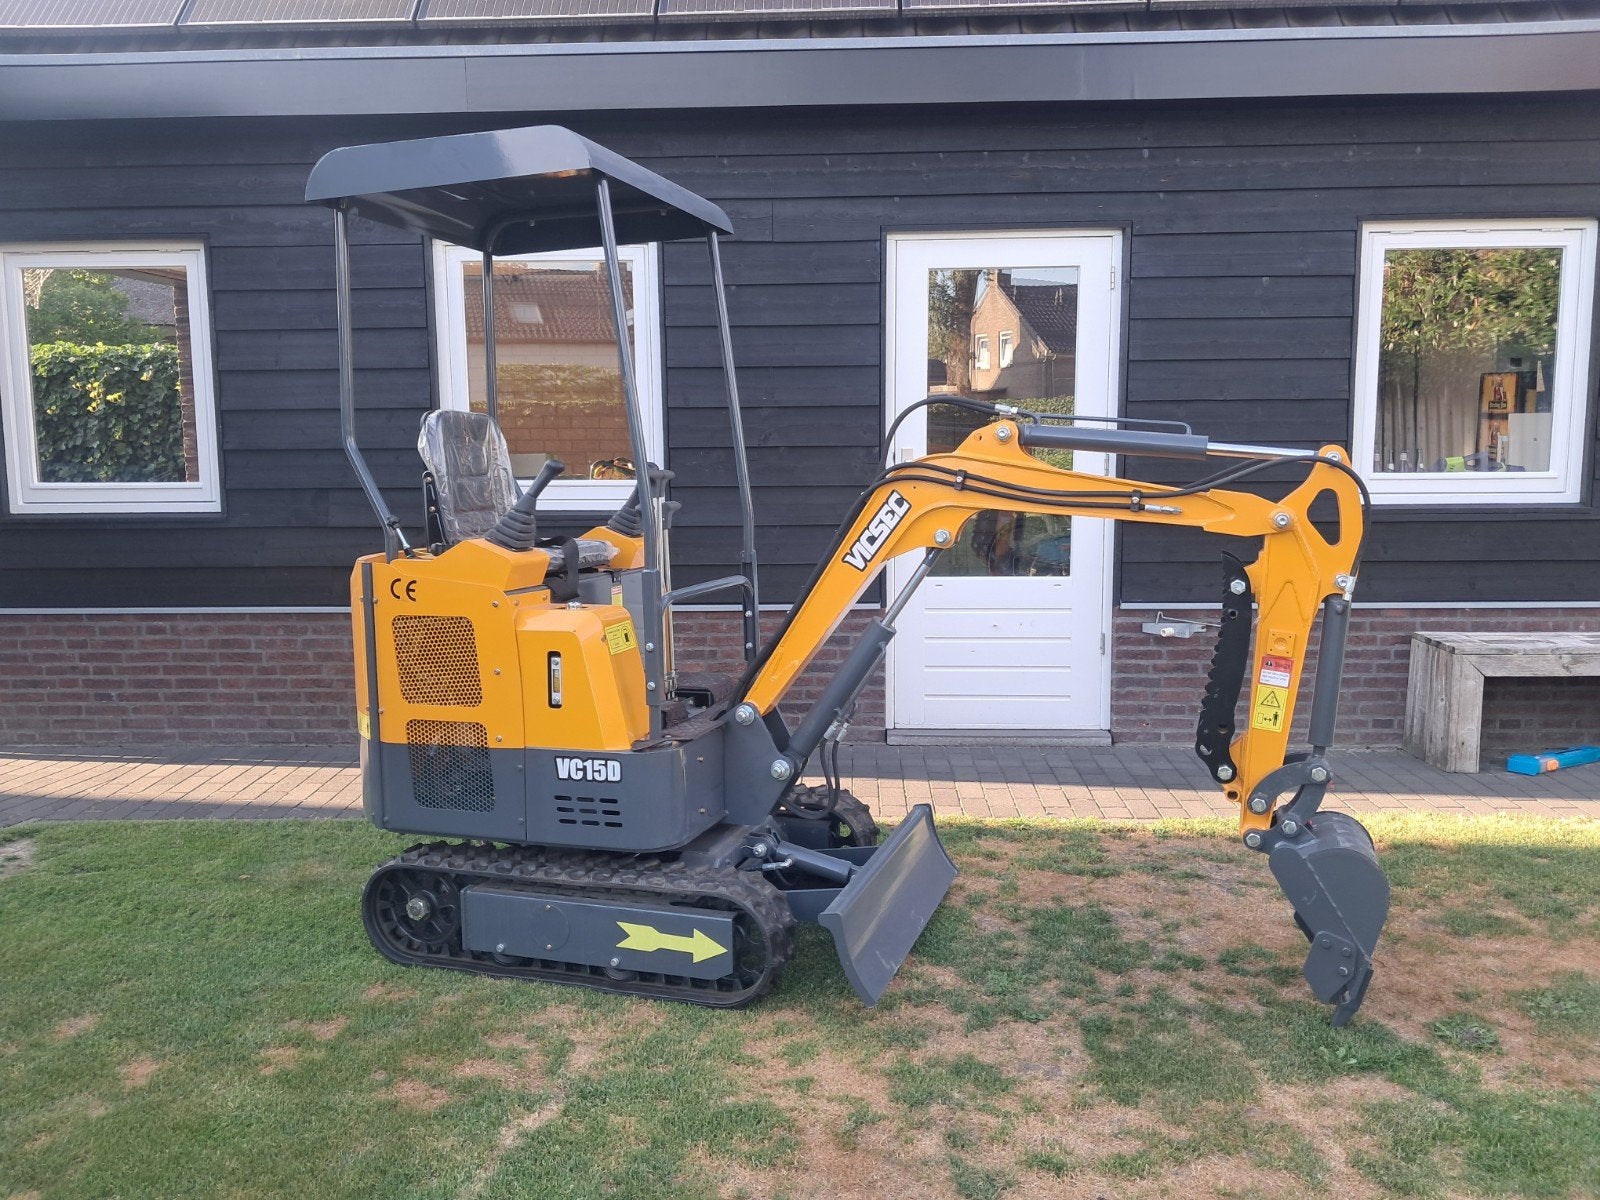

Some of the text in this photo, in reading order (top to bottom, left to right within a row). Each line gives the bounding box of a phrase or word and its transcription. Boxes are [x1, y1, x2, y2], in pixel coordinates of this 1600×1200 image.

[842, 490, 911, 571] VICSEC
[390, 578, 417, 602] CE
[555, 757, 622, 782] VC15D
